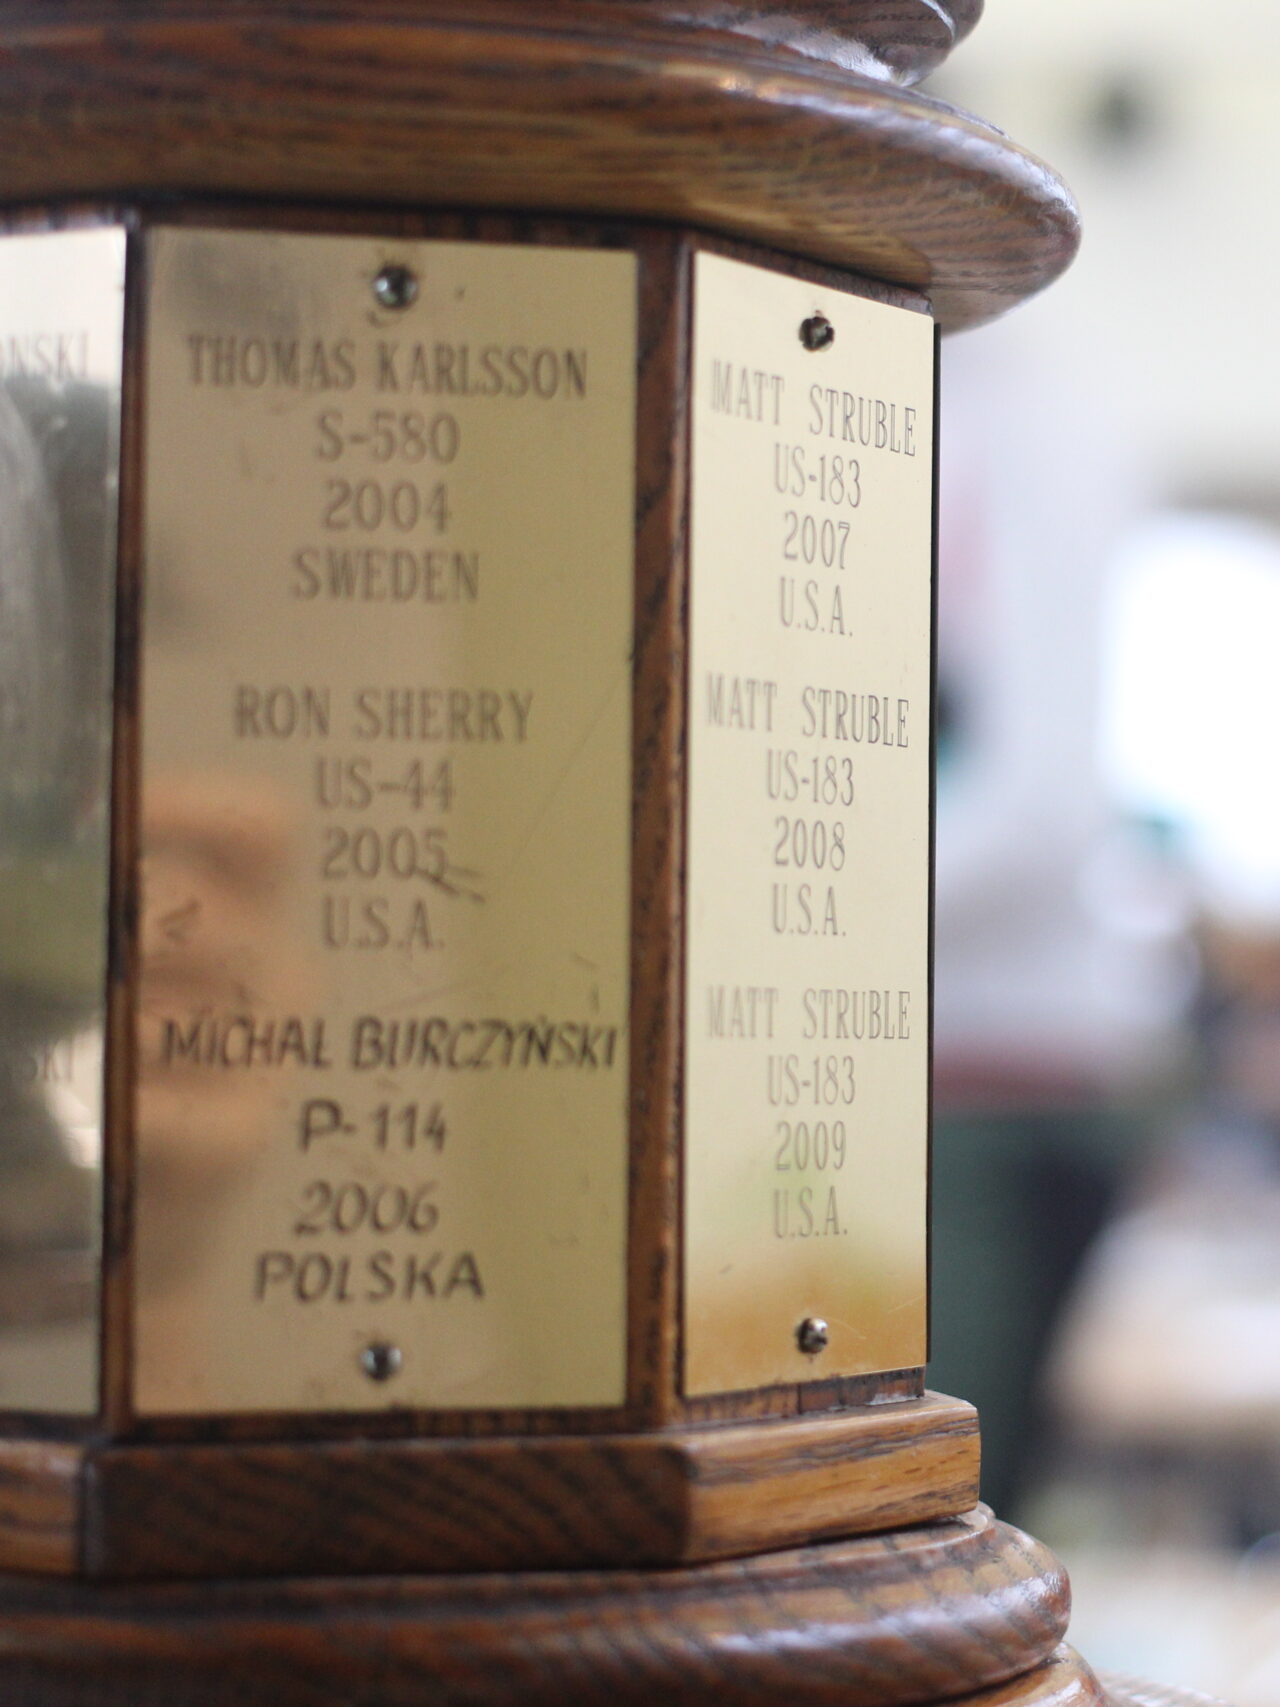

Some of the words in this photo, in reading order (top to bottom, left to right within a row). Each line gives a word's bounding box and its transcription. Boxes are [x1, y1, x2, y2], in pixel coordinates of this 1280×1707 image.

[187, 334, 357, 392] THOMAS
[377, 341, 588, 400] KARLSSON
[711, 359, 785, 426] MATT
[808, 384, 917, 457] STRUBLE
[315, 409, 461, 465] S-580
[774, 442, 861, 508] US-183
[322, 479, 453, 535] 2004
[783, 510, 851, 570] 2007
[292, 546, 480, 604] SWEDEN
[779, 575, 854, 638] U.S.A.
[233, 684, 332, 741] RON
[354, 687, 534, 742] SHERRY
[706, 671, 777, 732] MATT
[801, 686, 910, 748] STRUBLE
[315, 756, 456, 812] US-44
[765, 748, 855, 806] US-183
[321, 826, 449, 881] 2005
[773, 815, 846, 872] 2008
[319, 896, 446, 951] U.S.A.
[770, 883, 847, 936] U.S.A.
[706, 985, 779, 1040] MATT
[802, 988, 911, 1040] STRUBLE
[766, 1054, 857, 1106] US-183
[298, 1099, 450, 1153] P-114
[775, 1120, 847, 1171] 2009
[292, 1180, 441, 1236] 2006
[772, 1185, 848, 1239] U.S.A.
[253, 1250, 486, 1303] POLSKA
